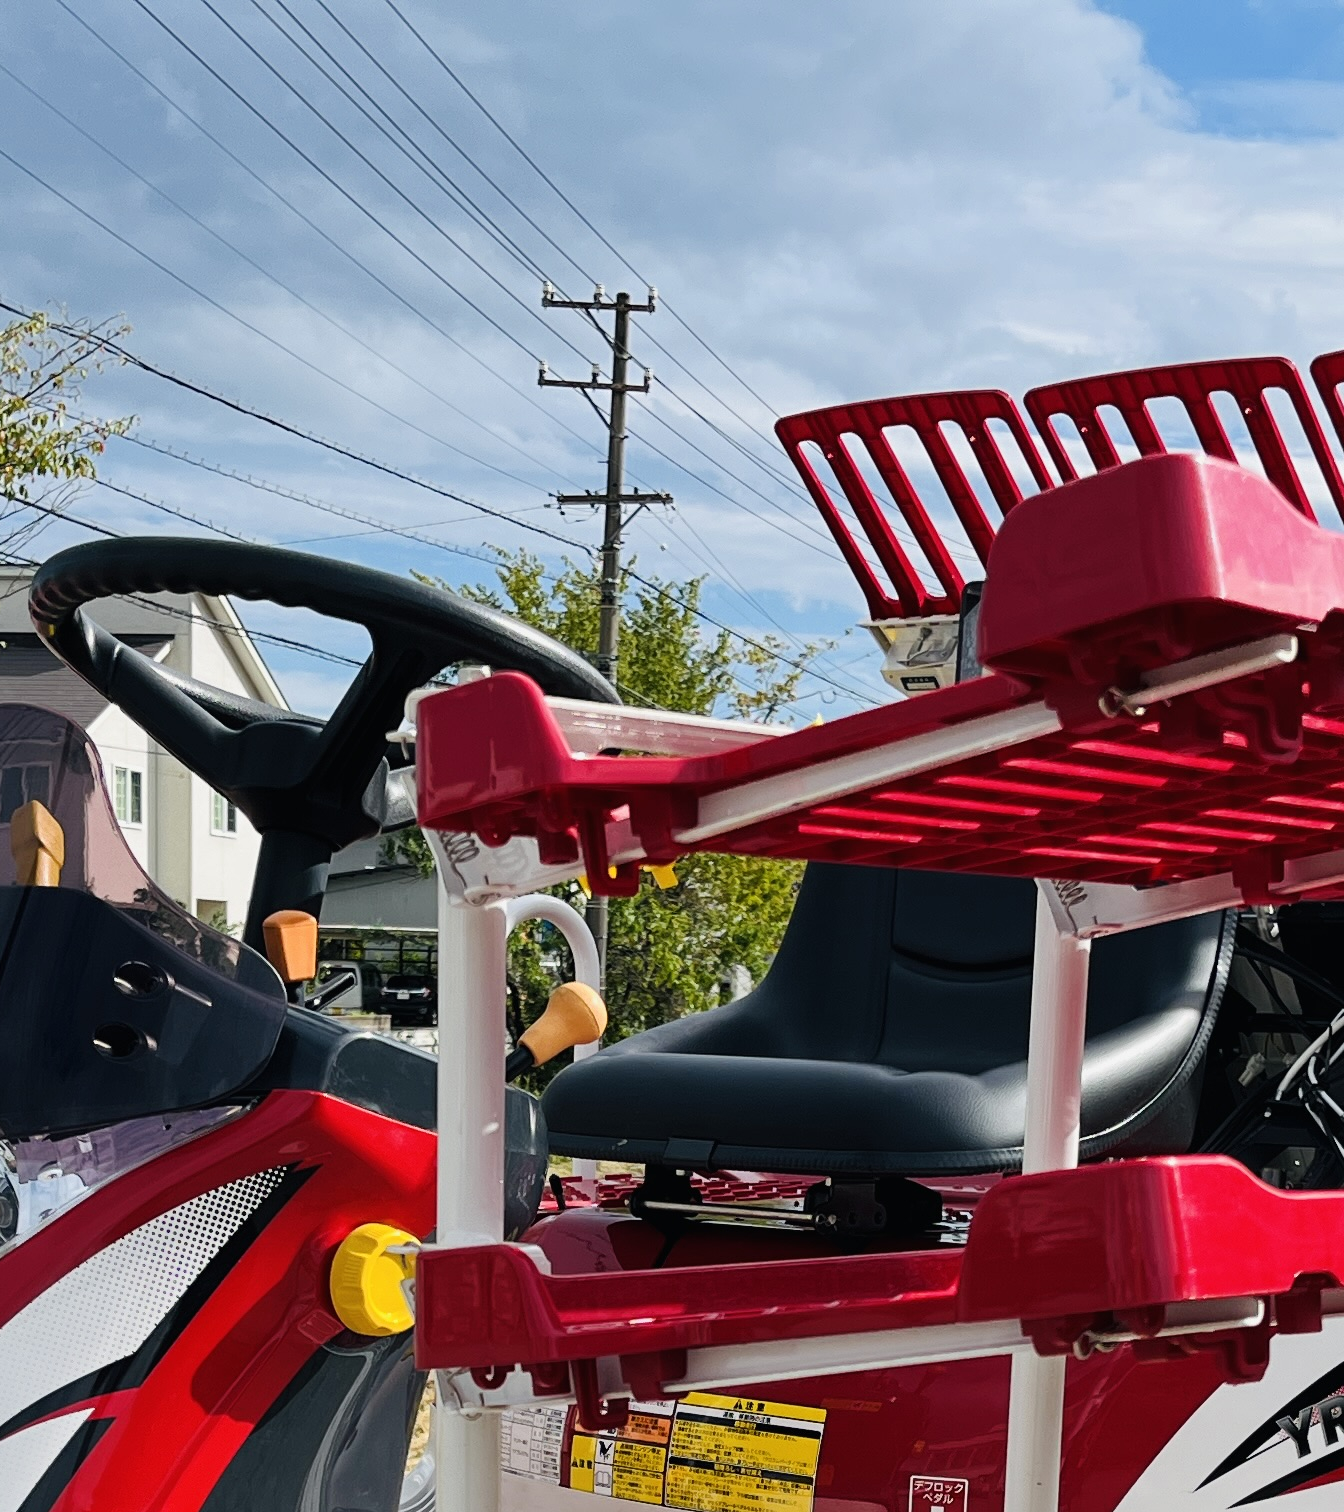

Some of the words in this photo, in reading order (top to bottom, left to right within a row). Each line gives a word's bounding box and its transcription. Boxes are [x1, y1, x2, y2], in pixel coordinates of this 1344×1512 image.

[914, 1480, 964, 1494] デフロック
[922, 1493, 954, 1504] ペダル
